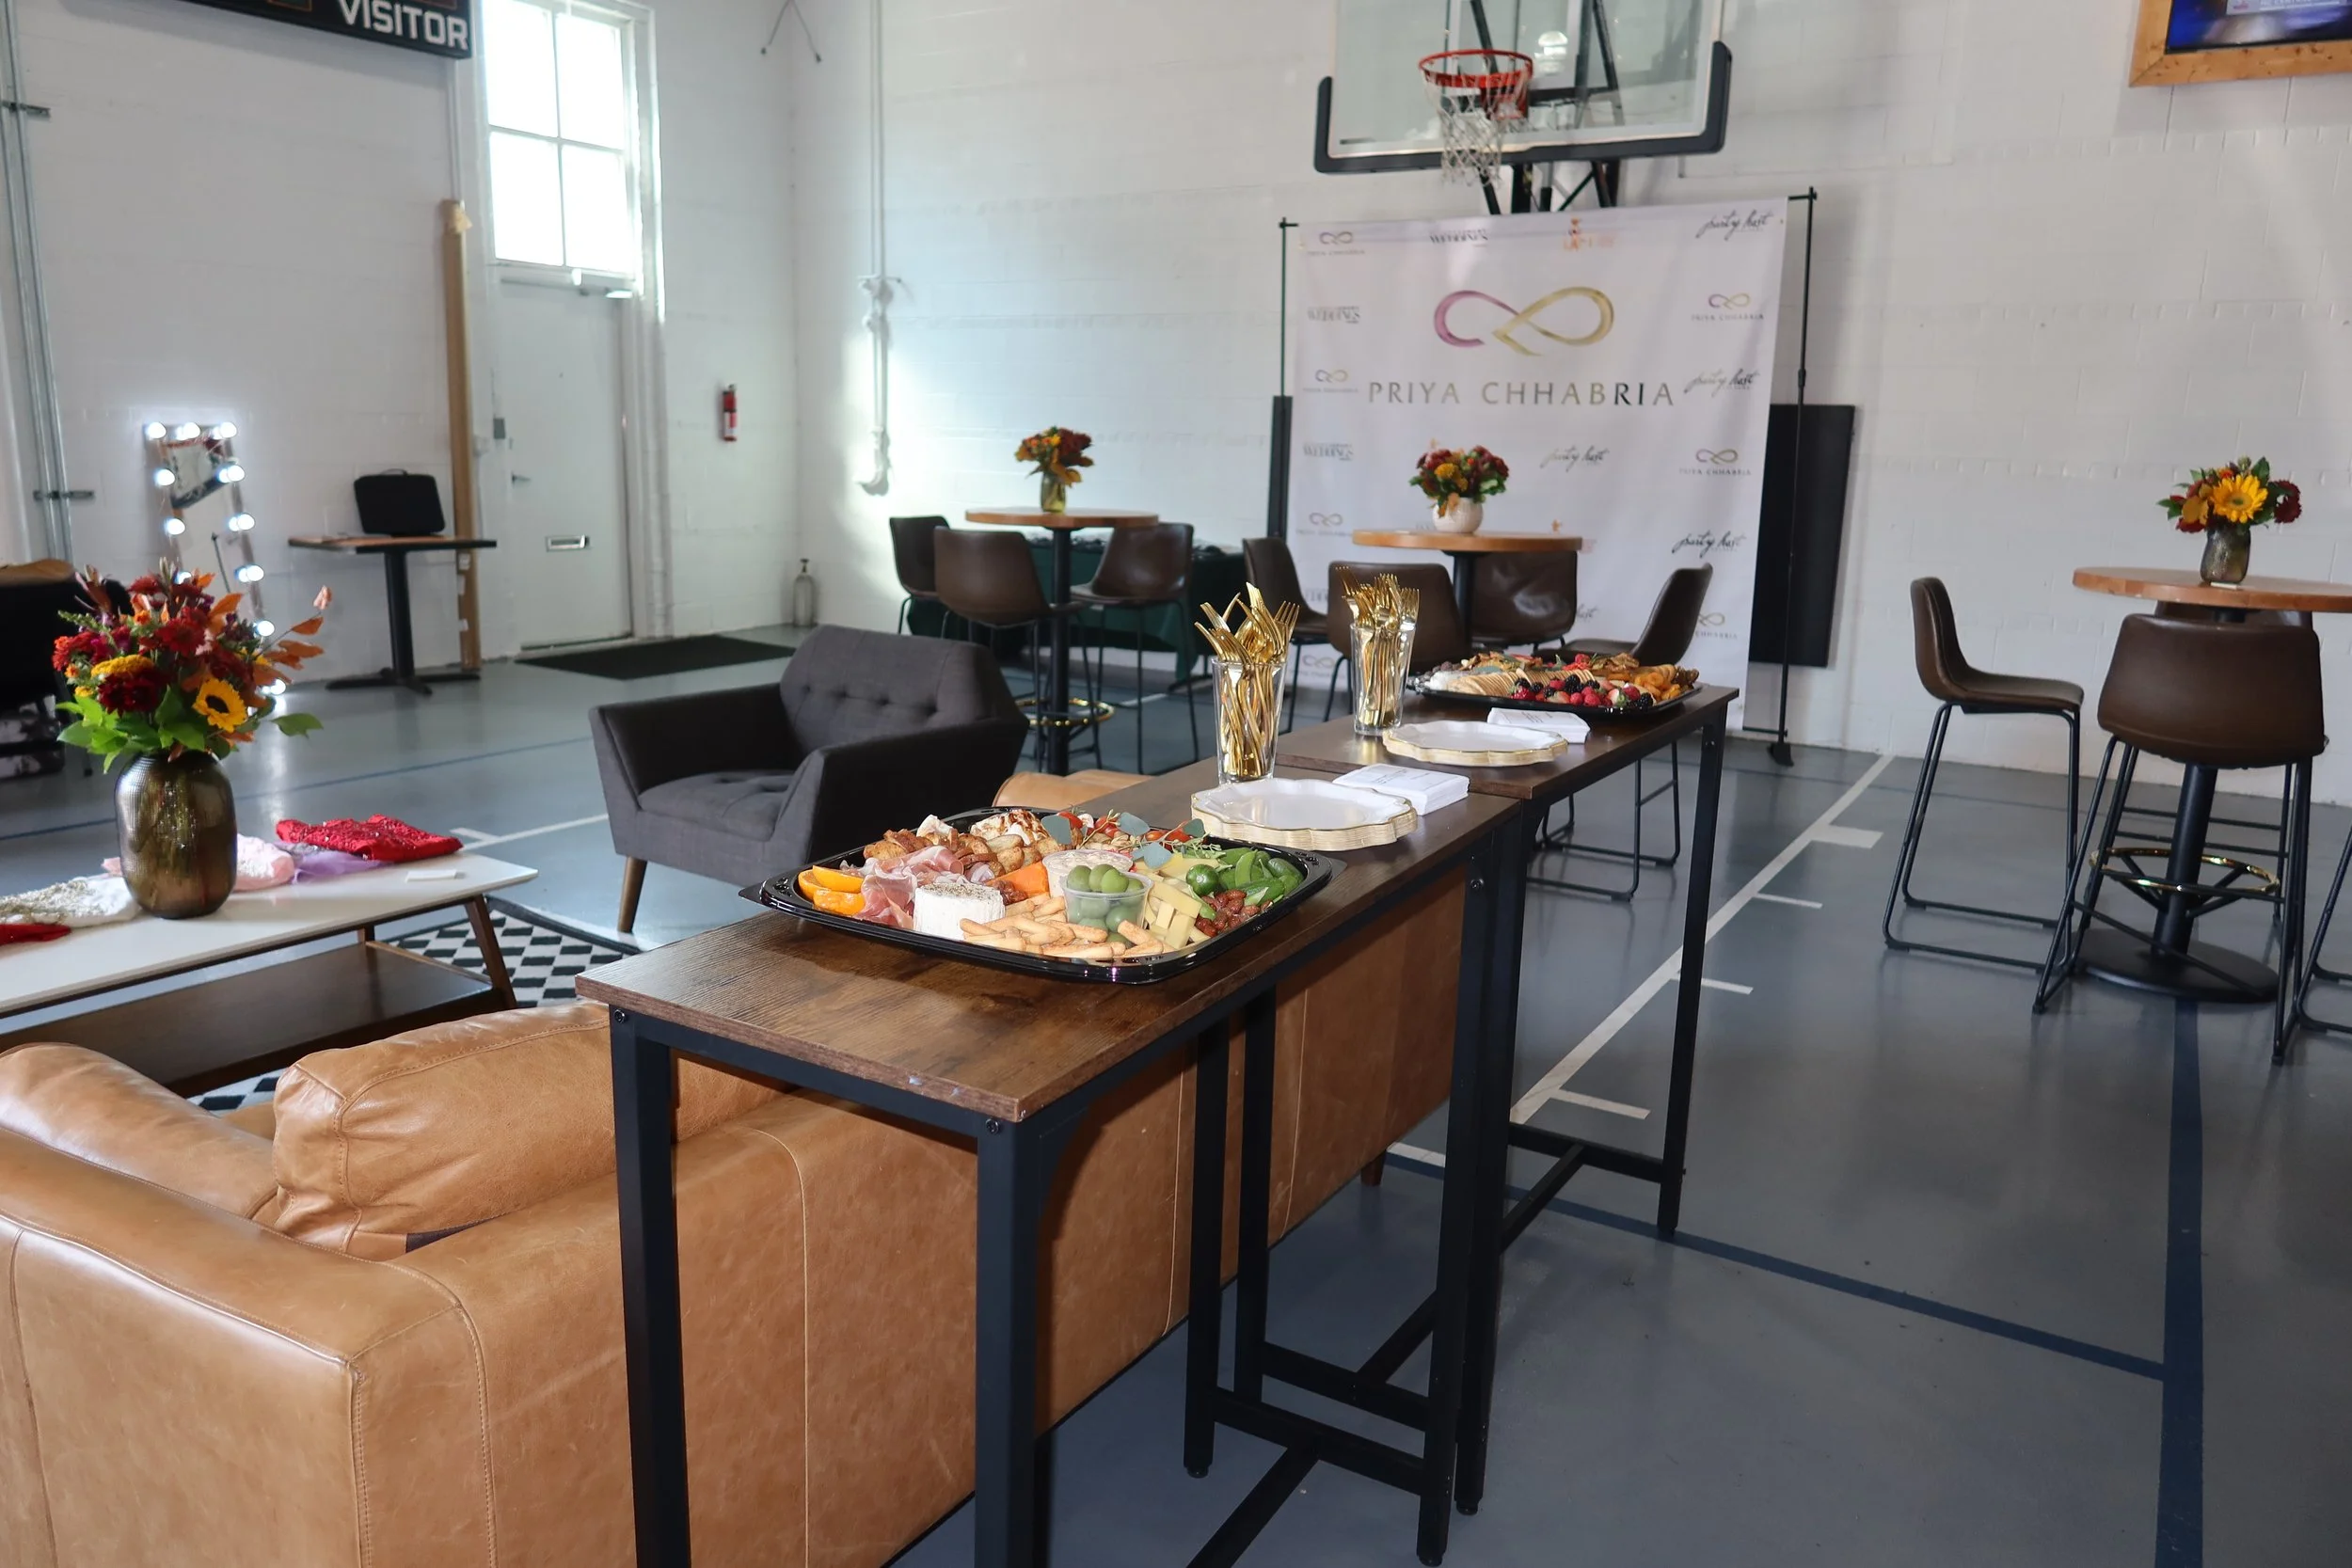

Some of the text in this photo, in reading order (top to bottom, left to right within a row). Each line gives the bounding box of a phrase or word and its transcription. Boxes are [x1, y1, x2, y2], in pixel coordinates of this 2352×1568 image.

[339, 0, 469, 50] VISITOR
[1368, 381, 1675, 406] PRIYA CHHABRIA
